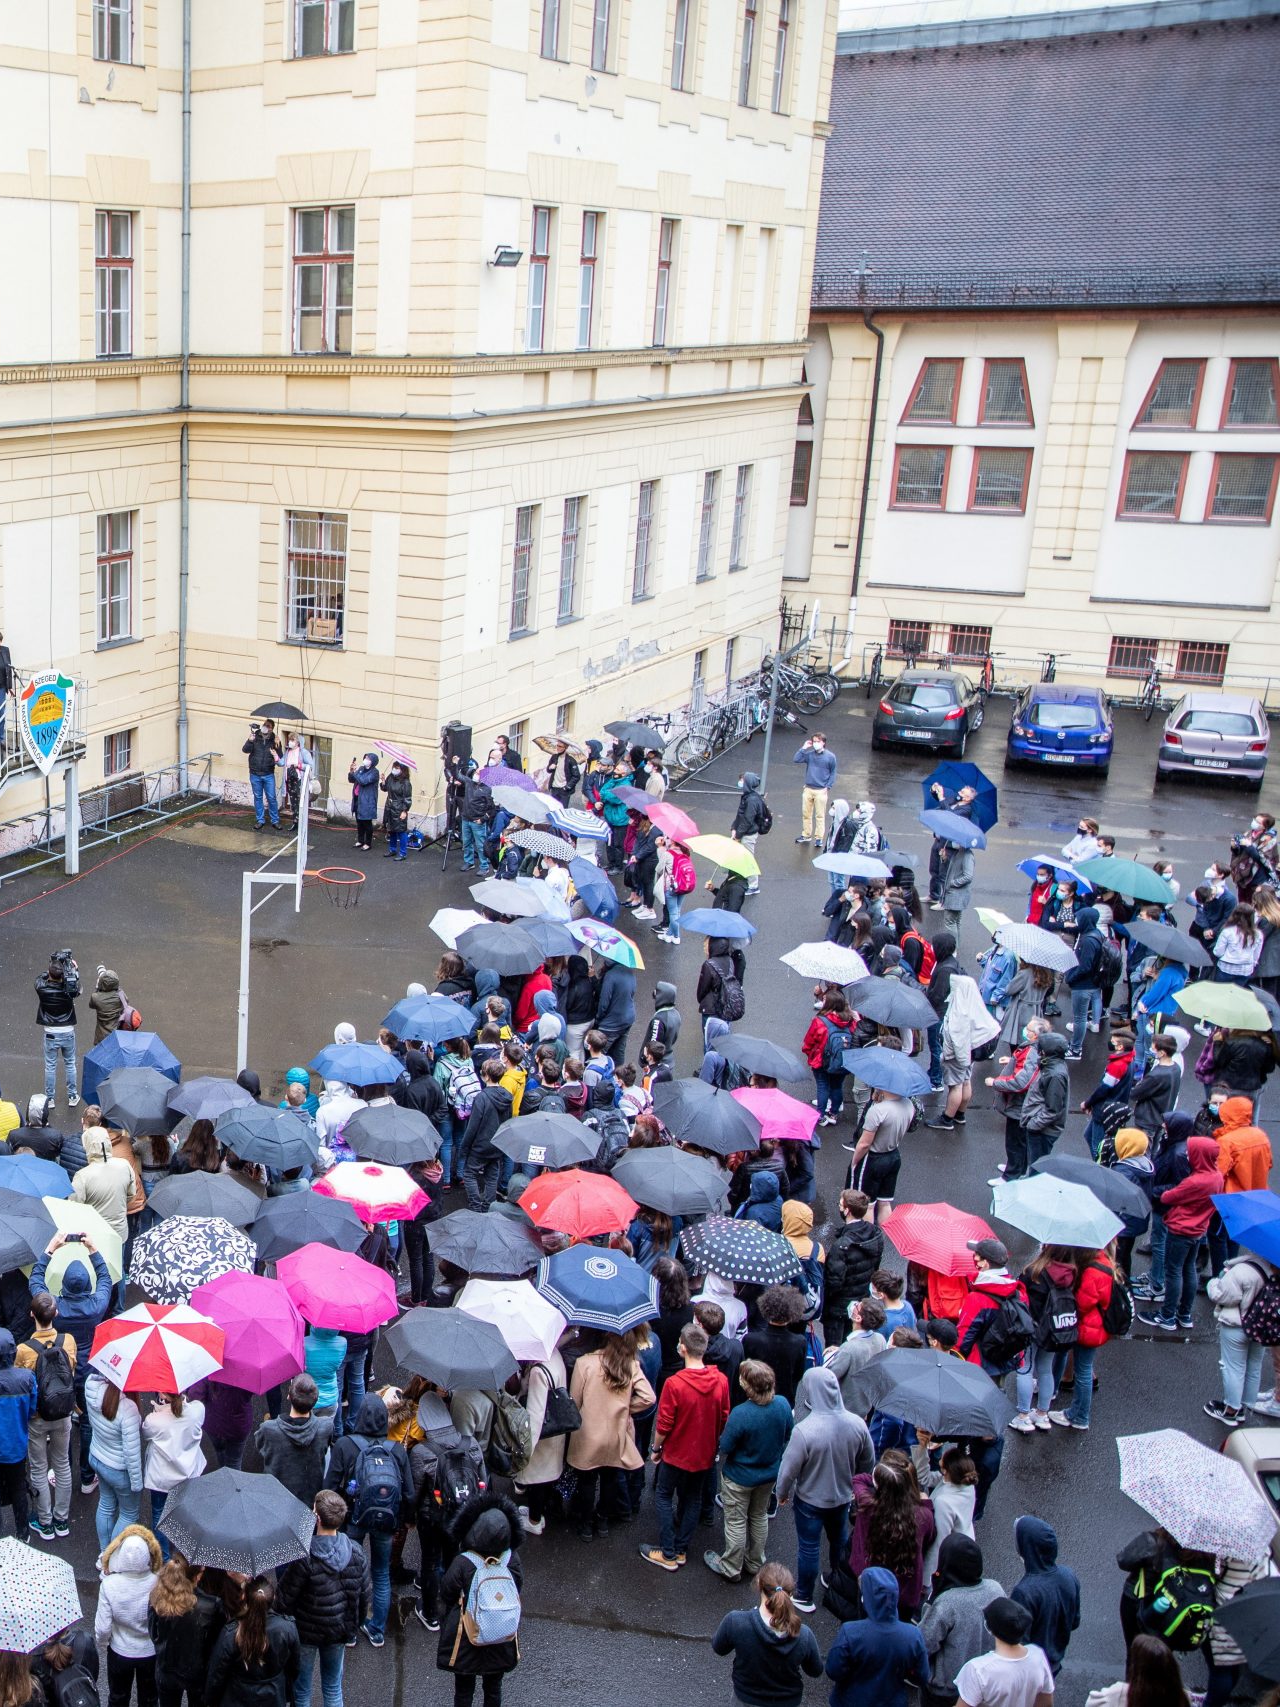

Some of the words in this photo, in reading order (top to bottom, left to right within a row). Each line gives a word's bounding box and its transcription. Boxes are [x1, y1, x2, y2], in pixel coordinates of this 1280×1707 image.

[34, 674, 57, 686] SZEGED
[36, 726, 58, 746] 1898
[52, 699, 73, 755] GIMNÁZIUM
[1052, 1310, 1078, 1329] VANS
